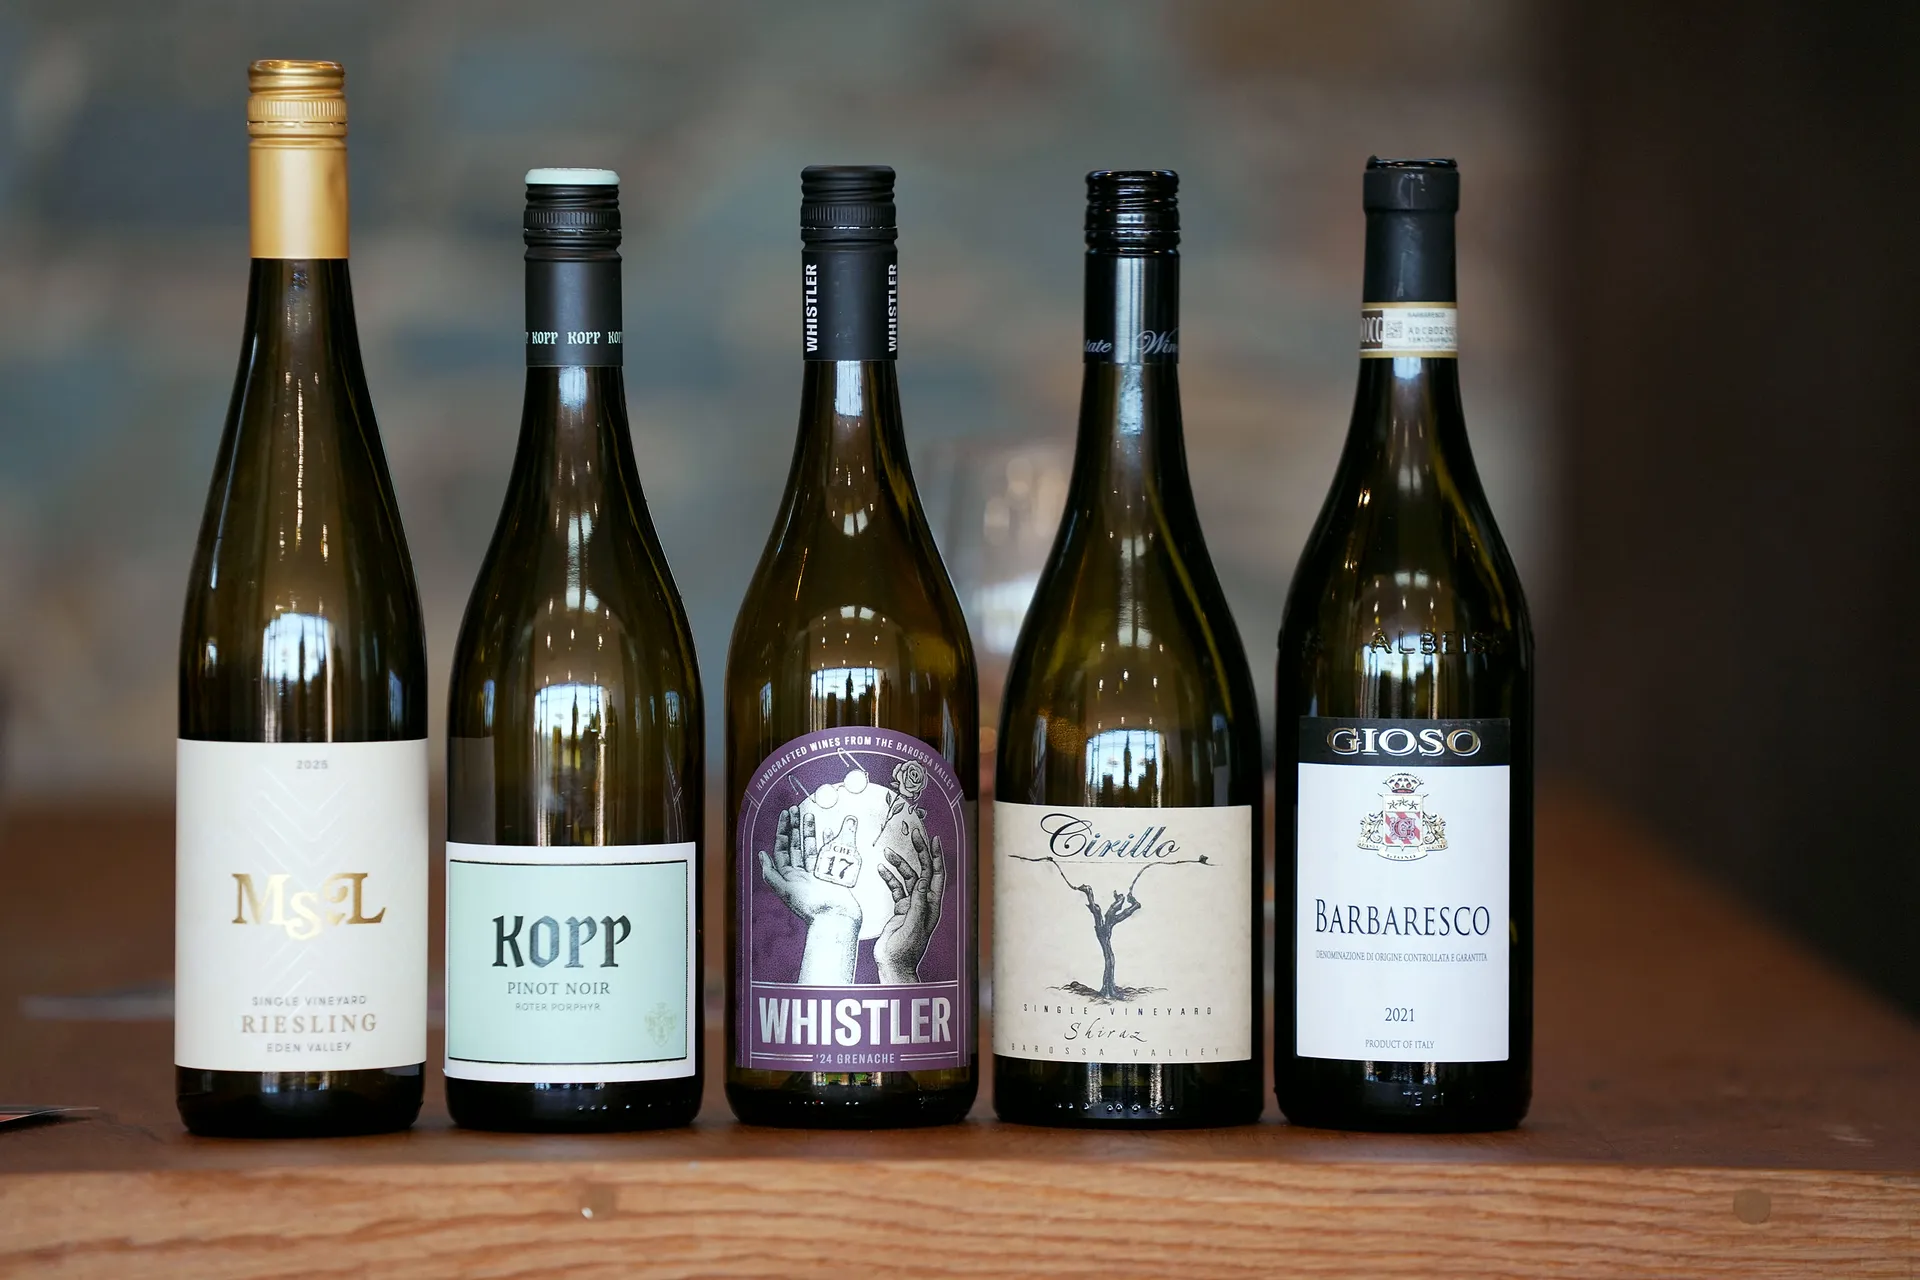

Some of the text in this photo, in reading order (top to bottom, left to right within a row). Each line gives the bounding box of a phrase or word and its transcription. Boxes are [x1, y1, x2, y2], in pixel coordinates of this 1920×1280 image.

[805, 264, 818, 353] WHISTLER
[888, 264, 898, 353] WHISTLER
[532, 331, 558, 344] KOPP
[567, 331, 601, 344] KOPP
[1326, 726, 1482, 757] GIOSO
[755, 735, 955, 791] HANDCRAFTED WINES FROM THE BAROSSA VALLEY
[1040, 813, 1180, 858] Cirillo
[824, 855, 854, 880] 17
[1315, 898, 1491, 936] BARBARESCO
[492, 914, 632, 968] KOPP
[1316, 950, 1366, 961] DENOMINAZIONE
[1366, 952, 1375, 962] DI
[1375, 953, 1403, 962] ORIGINE
[1403, 953, 1450, 963] CONTROLLATA
[508, 981, 611, 995] PINOT NOIR
[252, 995, 367, 1007] SINGLE VINEYARD
[515, 1002, 601, 1012] ROTER PORPHYR
[1023, 1003, 1213, 1016] SINGLE VINEYARD
[241, 1013, 378, 1034] RIESLING
[758, 996, 952, 1047] WHISTLER
[1384, 1007, 1415, 1022] 2021
[1063, 1017, 1148, 1043] Shiraz
[266, 1042, 352, 1053] EDEN VALLEY
[1010, 1042, 1220, 1057] BAROSSA VALLEY
[1365, 1039, 1435, 1049] PRODUCT OF ITALY
[815, 1053, 896, 1065] '24 GRENACHE
